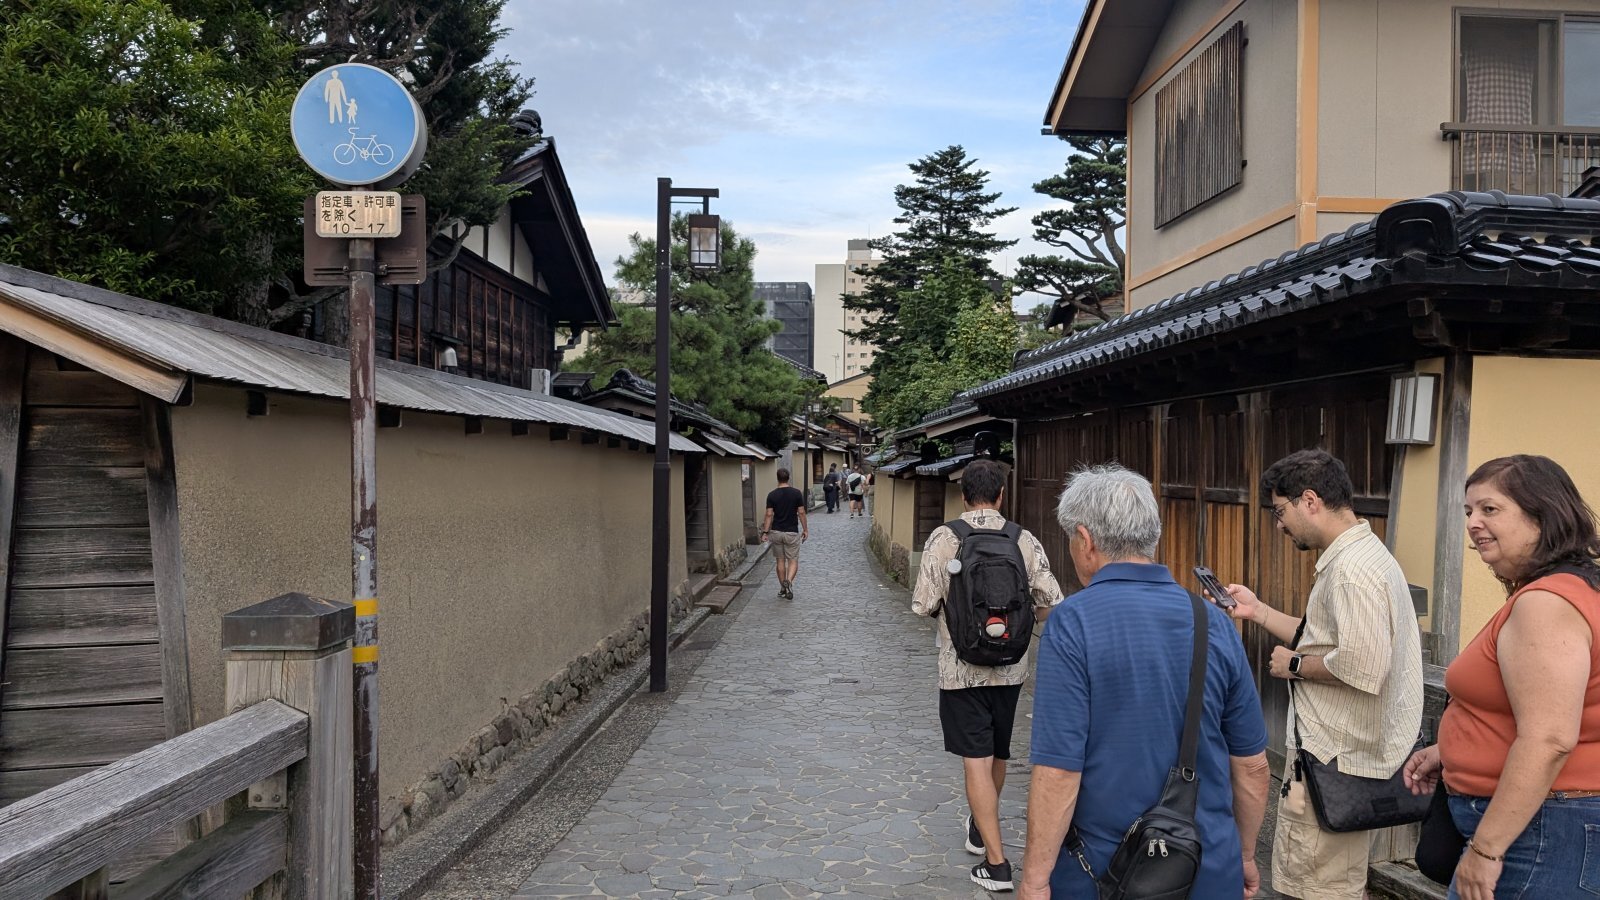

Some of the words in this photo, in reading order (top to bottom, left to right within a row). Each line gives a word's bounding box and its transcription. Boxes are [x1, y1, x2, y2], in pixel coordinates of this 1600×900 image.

[321, 195, 396, 208] 指定車・許可車
[321, 209, 356, 222] を除く
